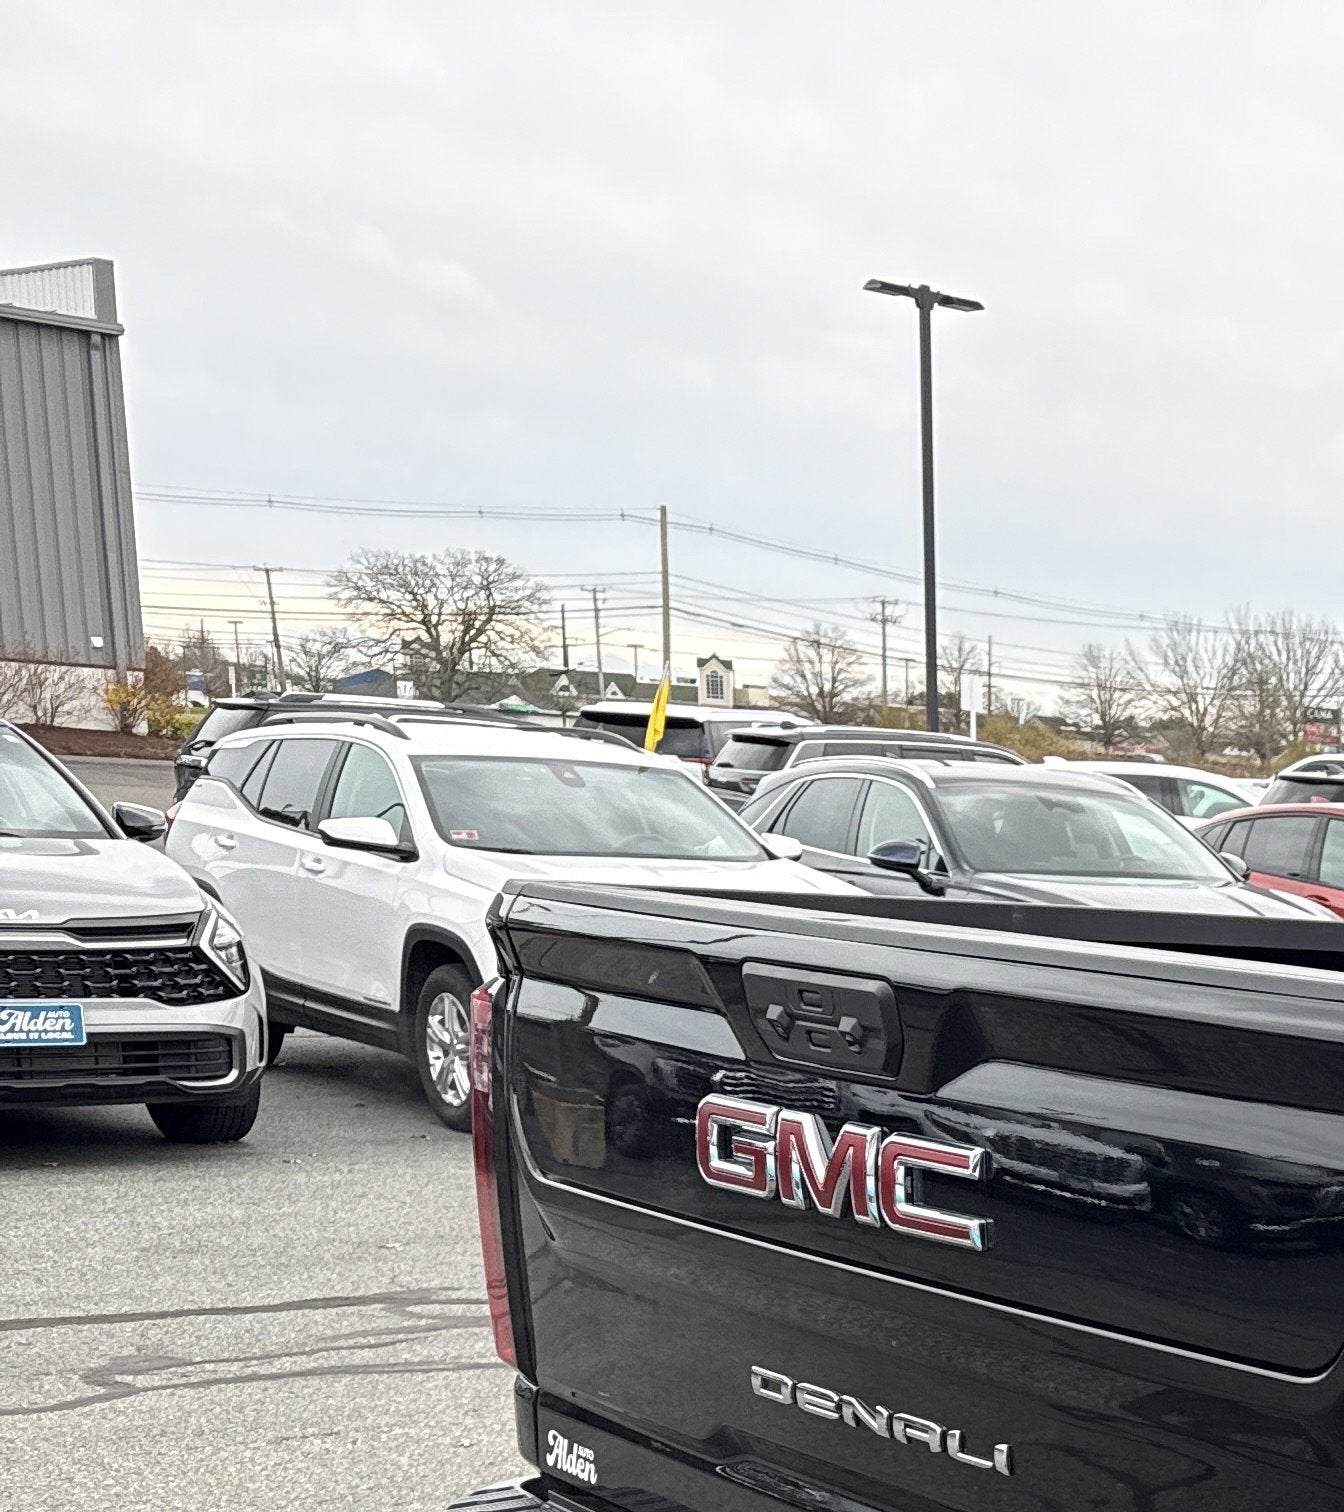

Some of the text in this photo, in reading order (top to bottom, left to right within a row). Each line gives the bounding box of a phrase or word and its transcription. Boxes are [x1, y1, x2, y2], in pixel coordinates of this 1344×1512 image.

[0, 1009, 75, 1032] Alden
[46, 1010, 71, 1018] AUTO
[41, 1031, 75, 1040] LOCAL
[695, 1093, 994, 1252] GMC
[750, 1365, 1013, 1477] DENALI
[546, 1429, 598, 1485] Alden
